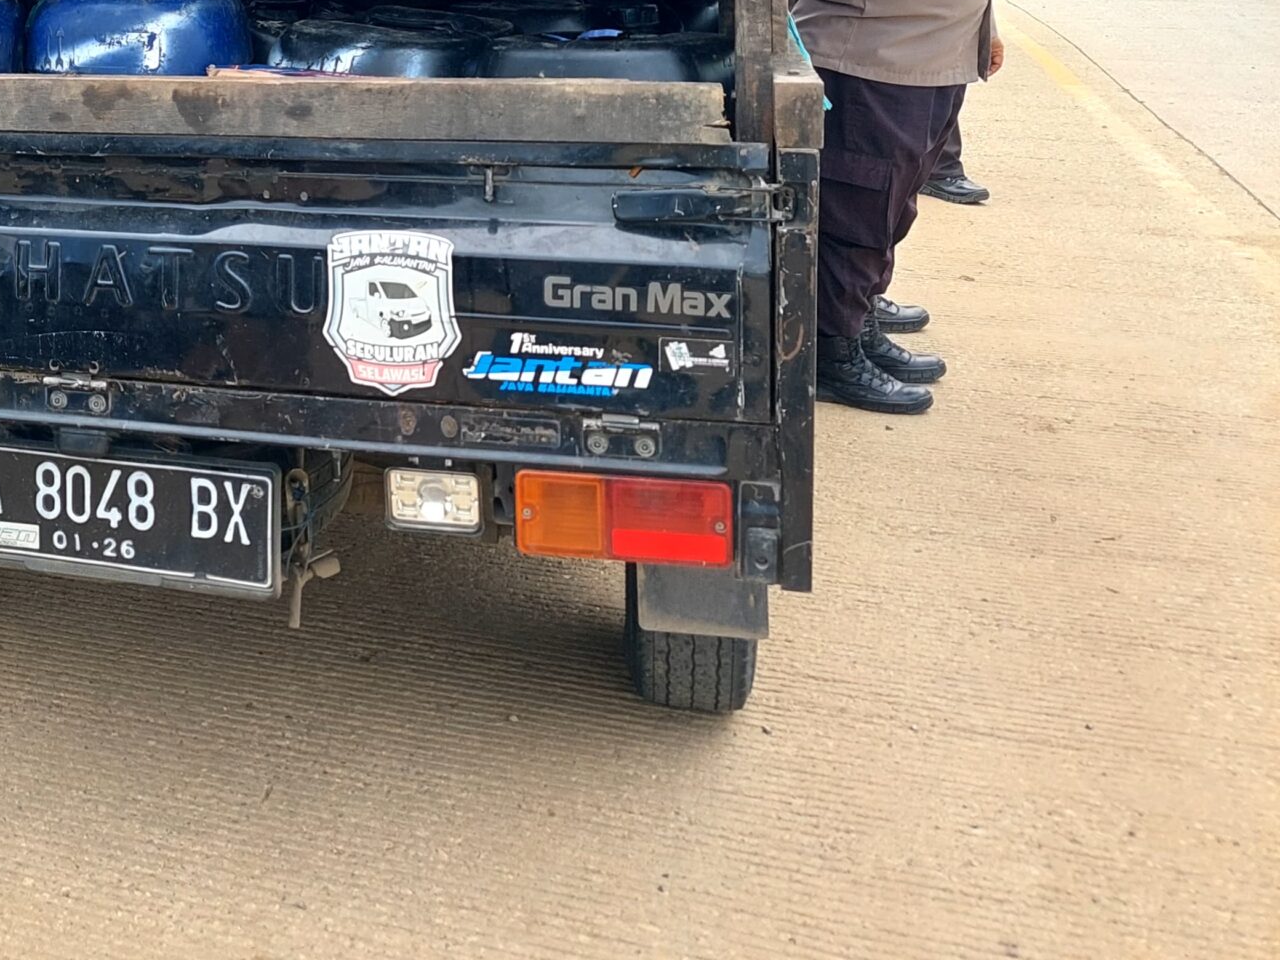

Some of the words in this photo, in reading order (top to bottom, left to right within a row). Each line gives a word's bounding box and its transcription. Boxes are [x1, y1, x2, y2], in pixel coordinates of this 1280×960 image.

[331, 232, 450, 266] JANTAN
[374, 254, 437, 272] KALIMANTAN
[543, 275, 638, 313] Gran
[646, 281, 732, 319] Max
[521, 342, 604, 359] Anniversary
[35, 461, 155, 531] 8048
[190, 477, 251, 546] BX
